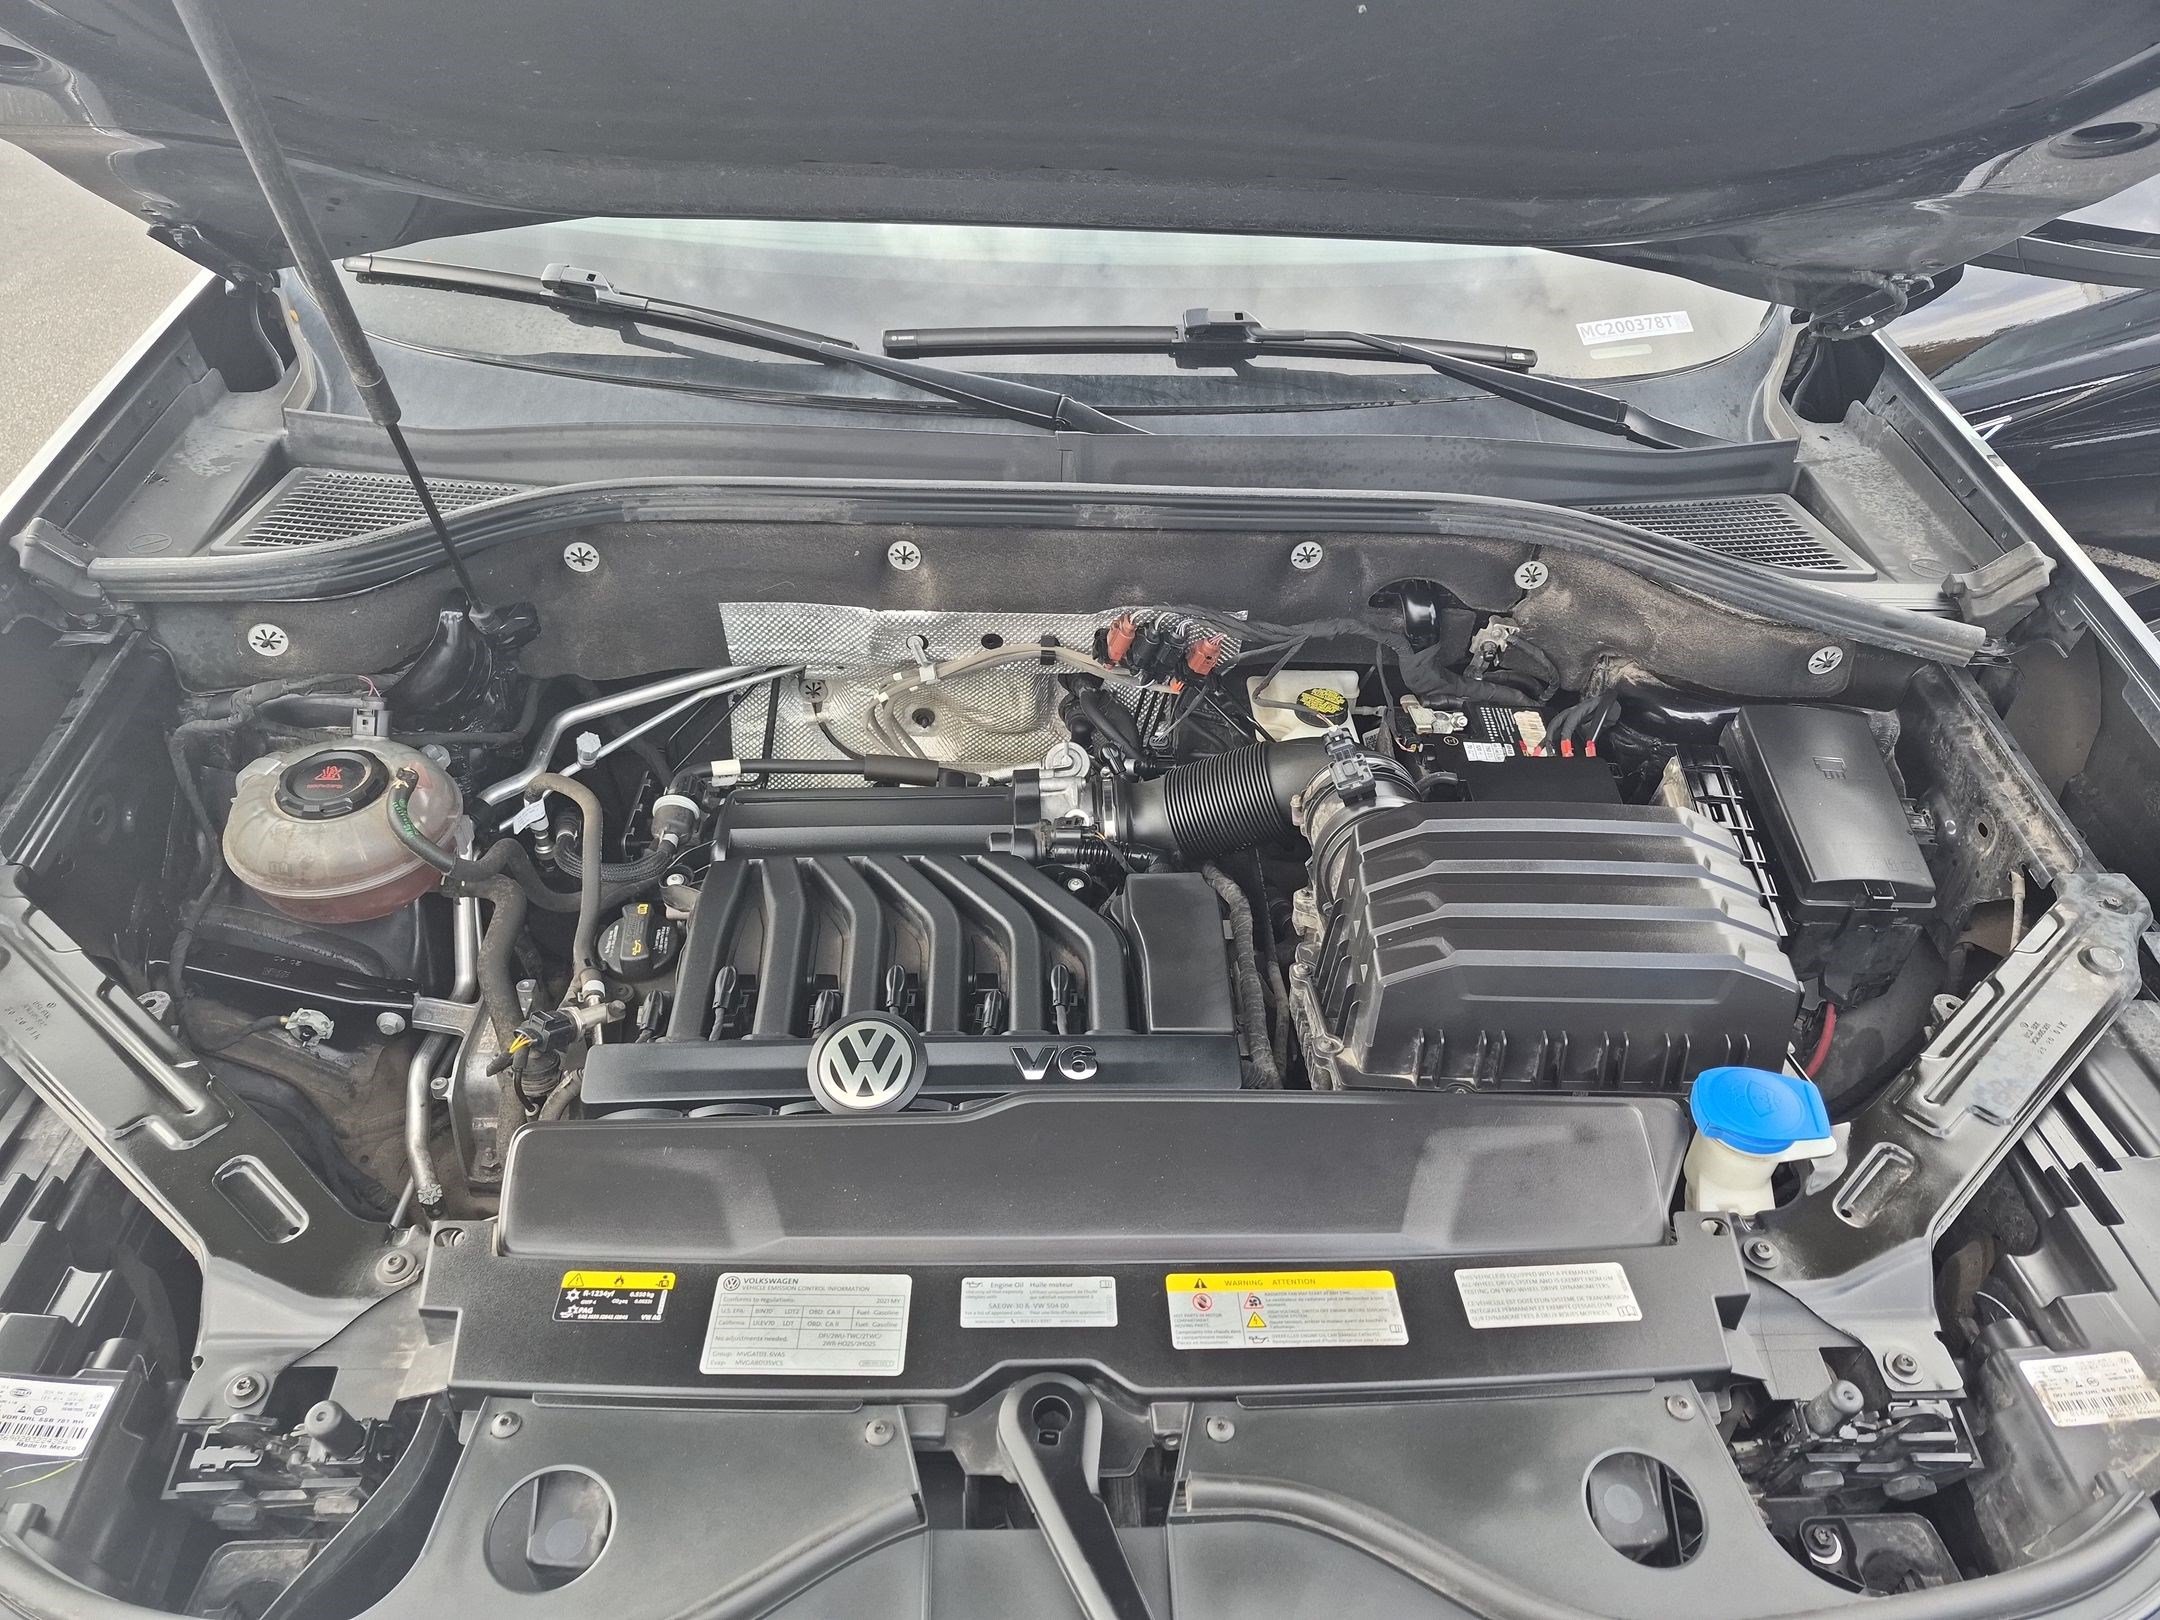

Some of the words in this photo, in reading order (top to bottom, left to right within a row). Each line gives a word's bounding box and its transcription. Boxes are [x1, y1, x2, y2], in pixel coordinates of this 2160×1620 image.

[1580, 315, 1672, 338] MC200378T
[1010, 1044, 1098, 1081] V6
[743, 1277, 800, 1285] VOLKSWAGEN
[1224, 1279, 1264, 1287] WARNING
[1272, 1278, 1316, 1286] ATTENTION
[990, 1282, 1013, 1290] Engine
[579, 1306, 594, 1314] PAG
[16, 1441, 38, 1449] Made
[49, 1443, 77, 1451] Mexico
